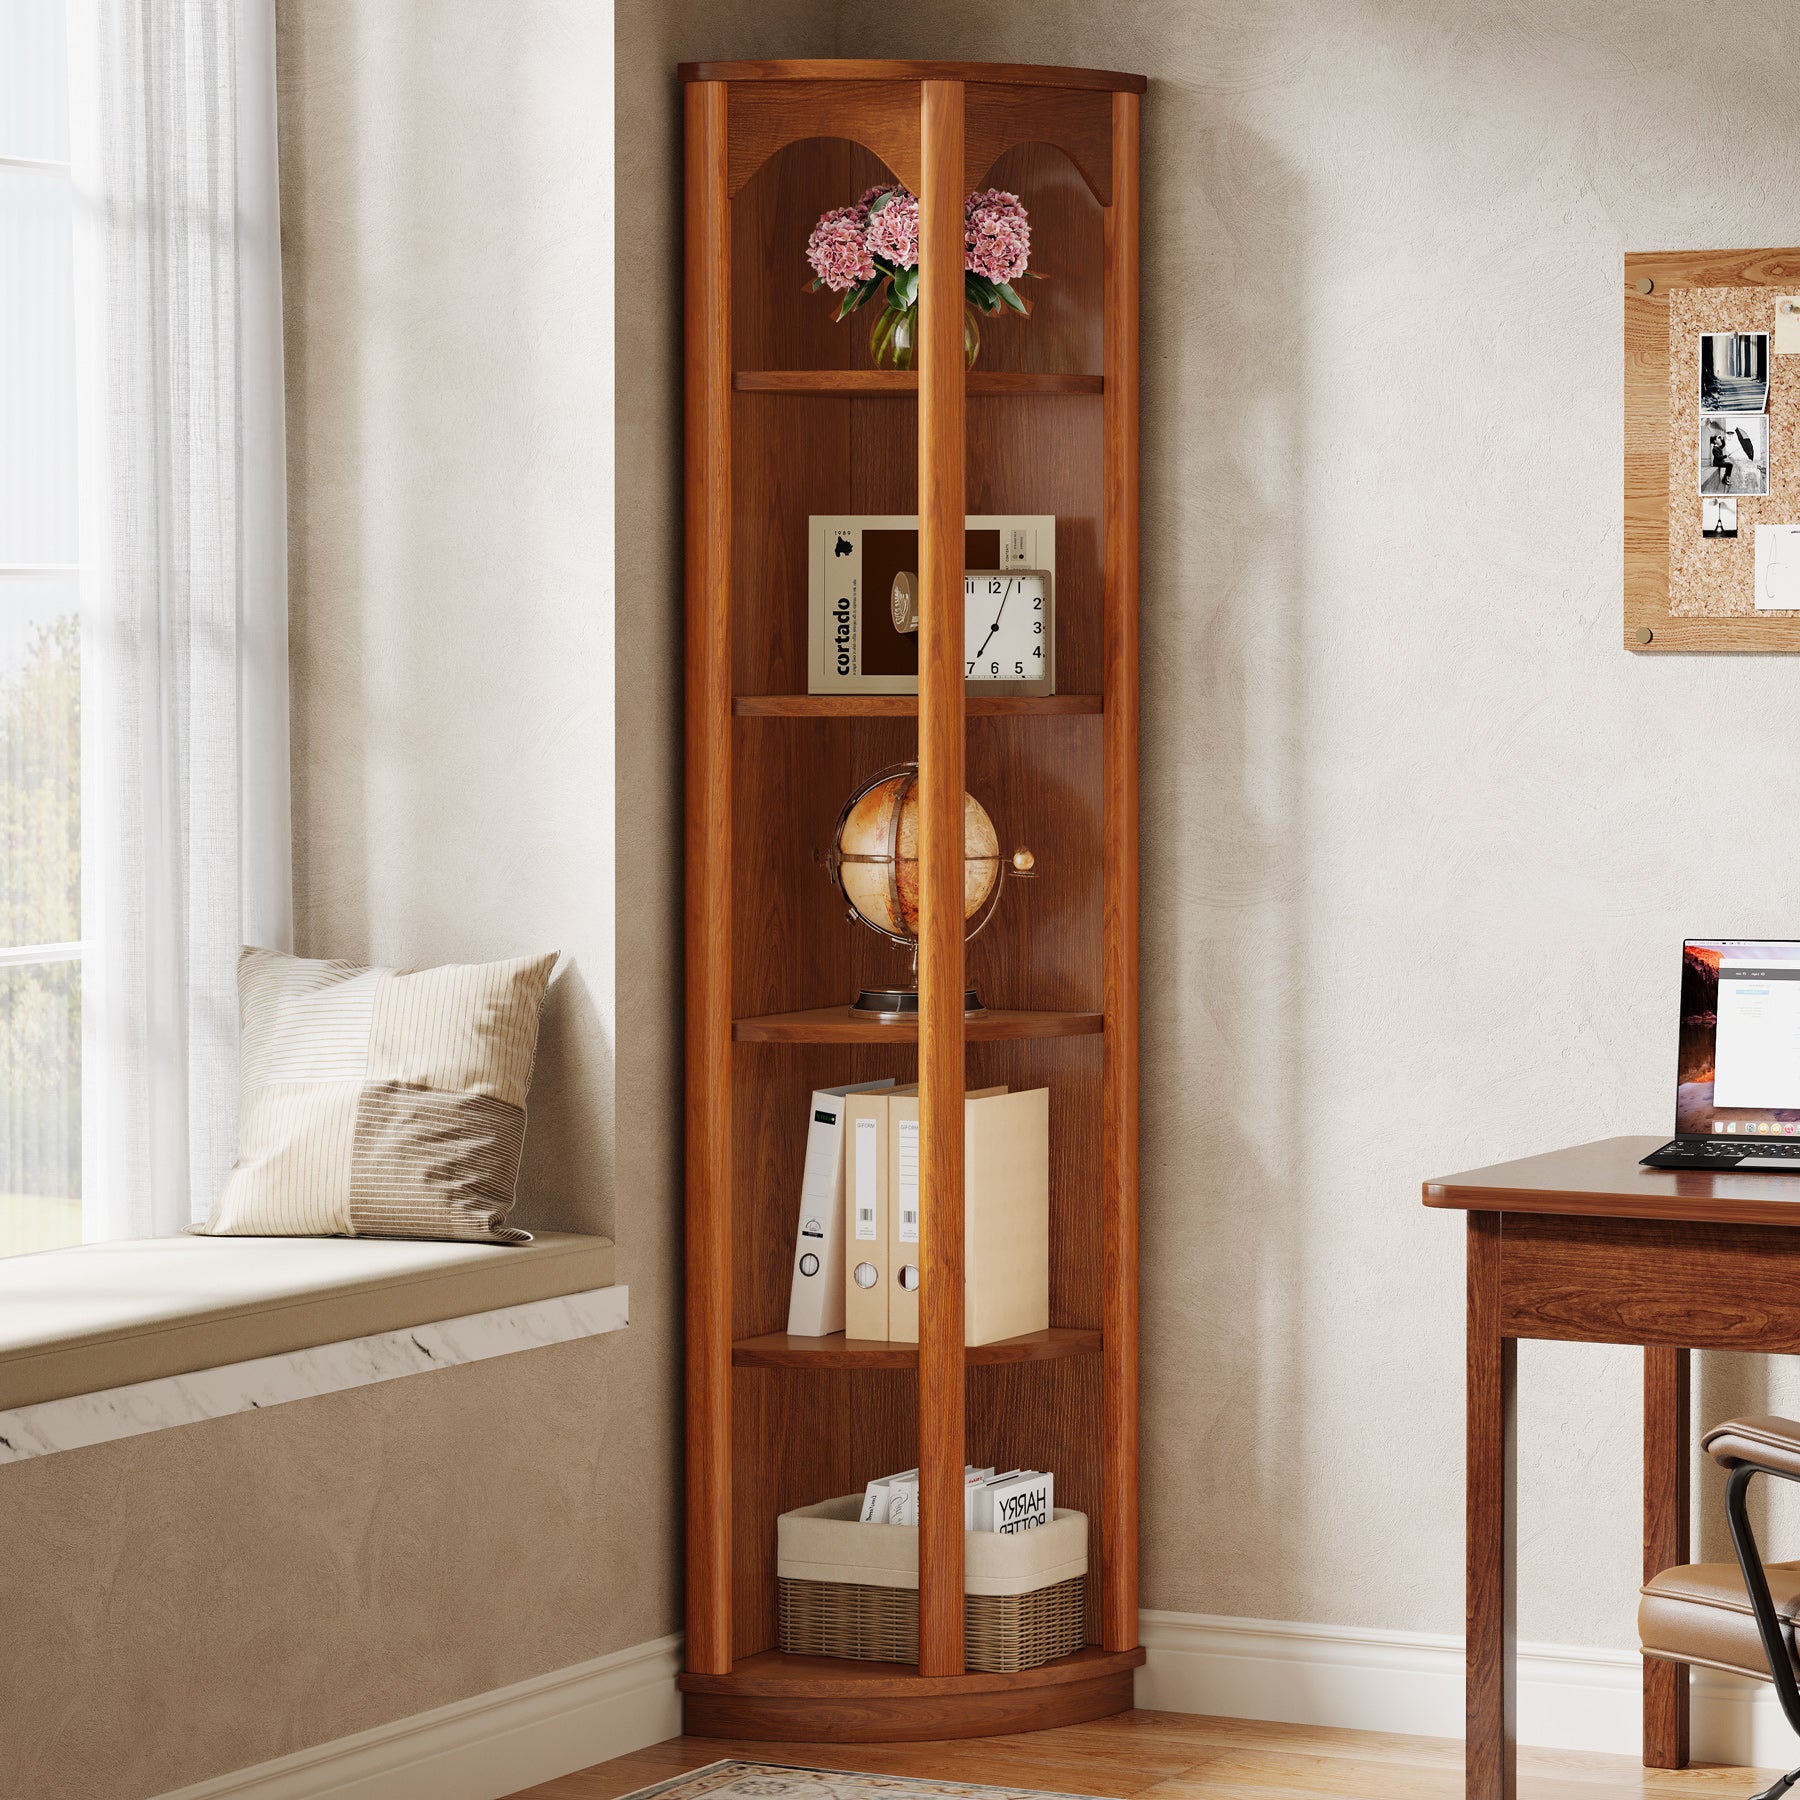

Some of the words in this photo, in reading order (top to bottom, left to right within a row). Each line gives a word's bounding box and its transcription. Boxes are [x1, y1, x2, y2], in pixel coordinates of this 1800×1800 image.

[988, 581, 1002, 594] 12
[1017, 582, 1021, 594] 1
[1032, 597, 1042, 610] 2
[1032, 621, 1042, 634] 3
[832, 597, 850, 676] cortado
[1032, 645, 1042, 659] 4
[966, 662, 976, 674] 7
[990, 662, 999, 675] 6
[1014, 662, 1023, 675] 5
